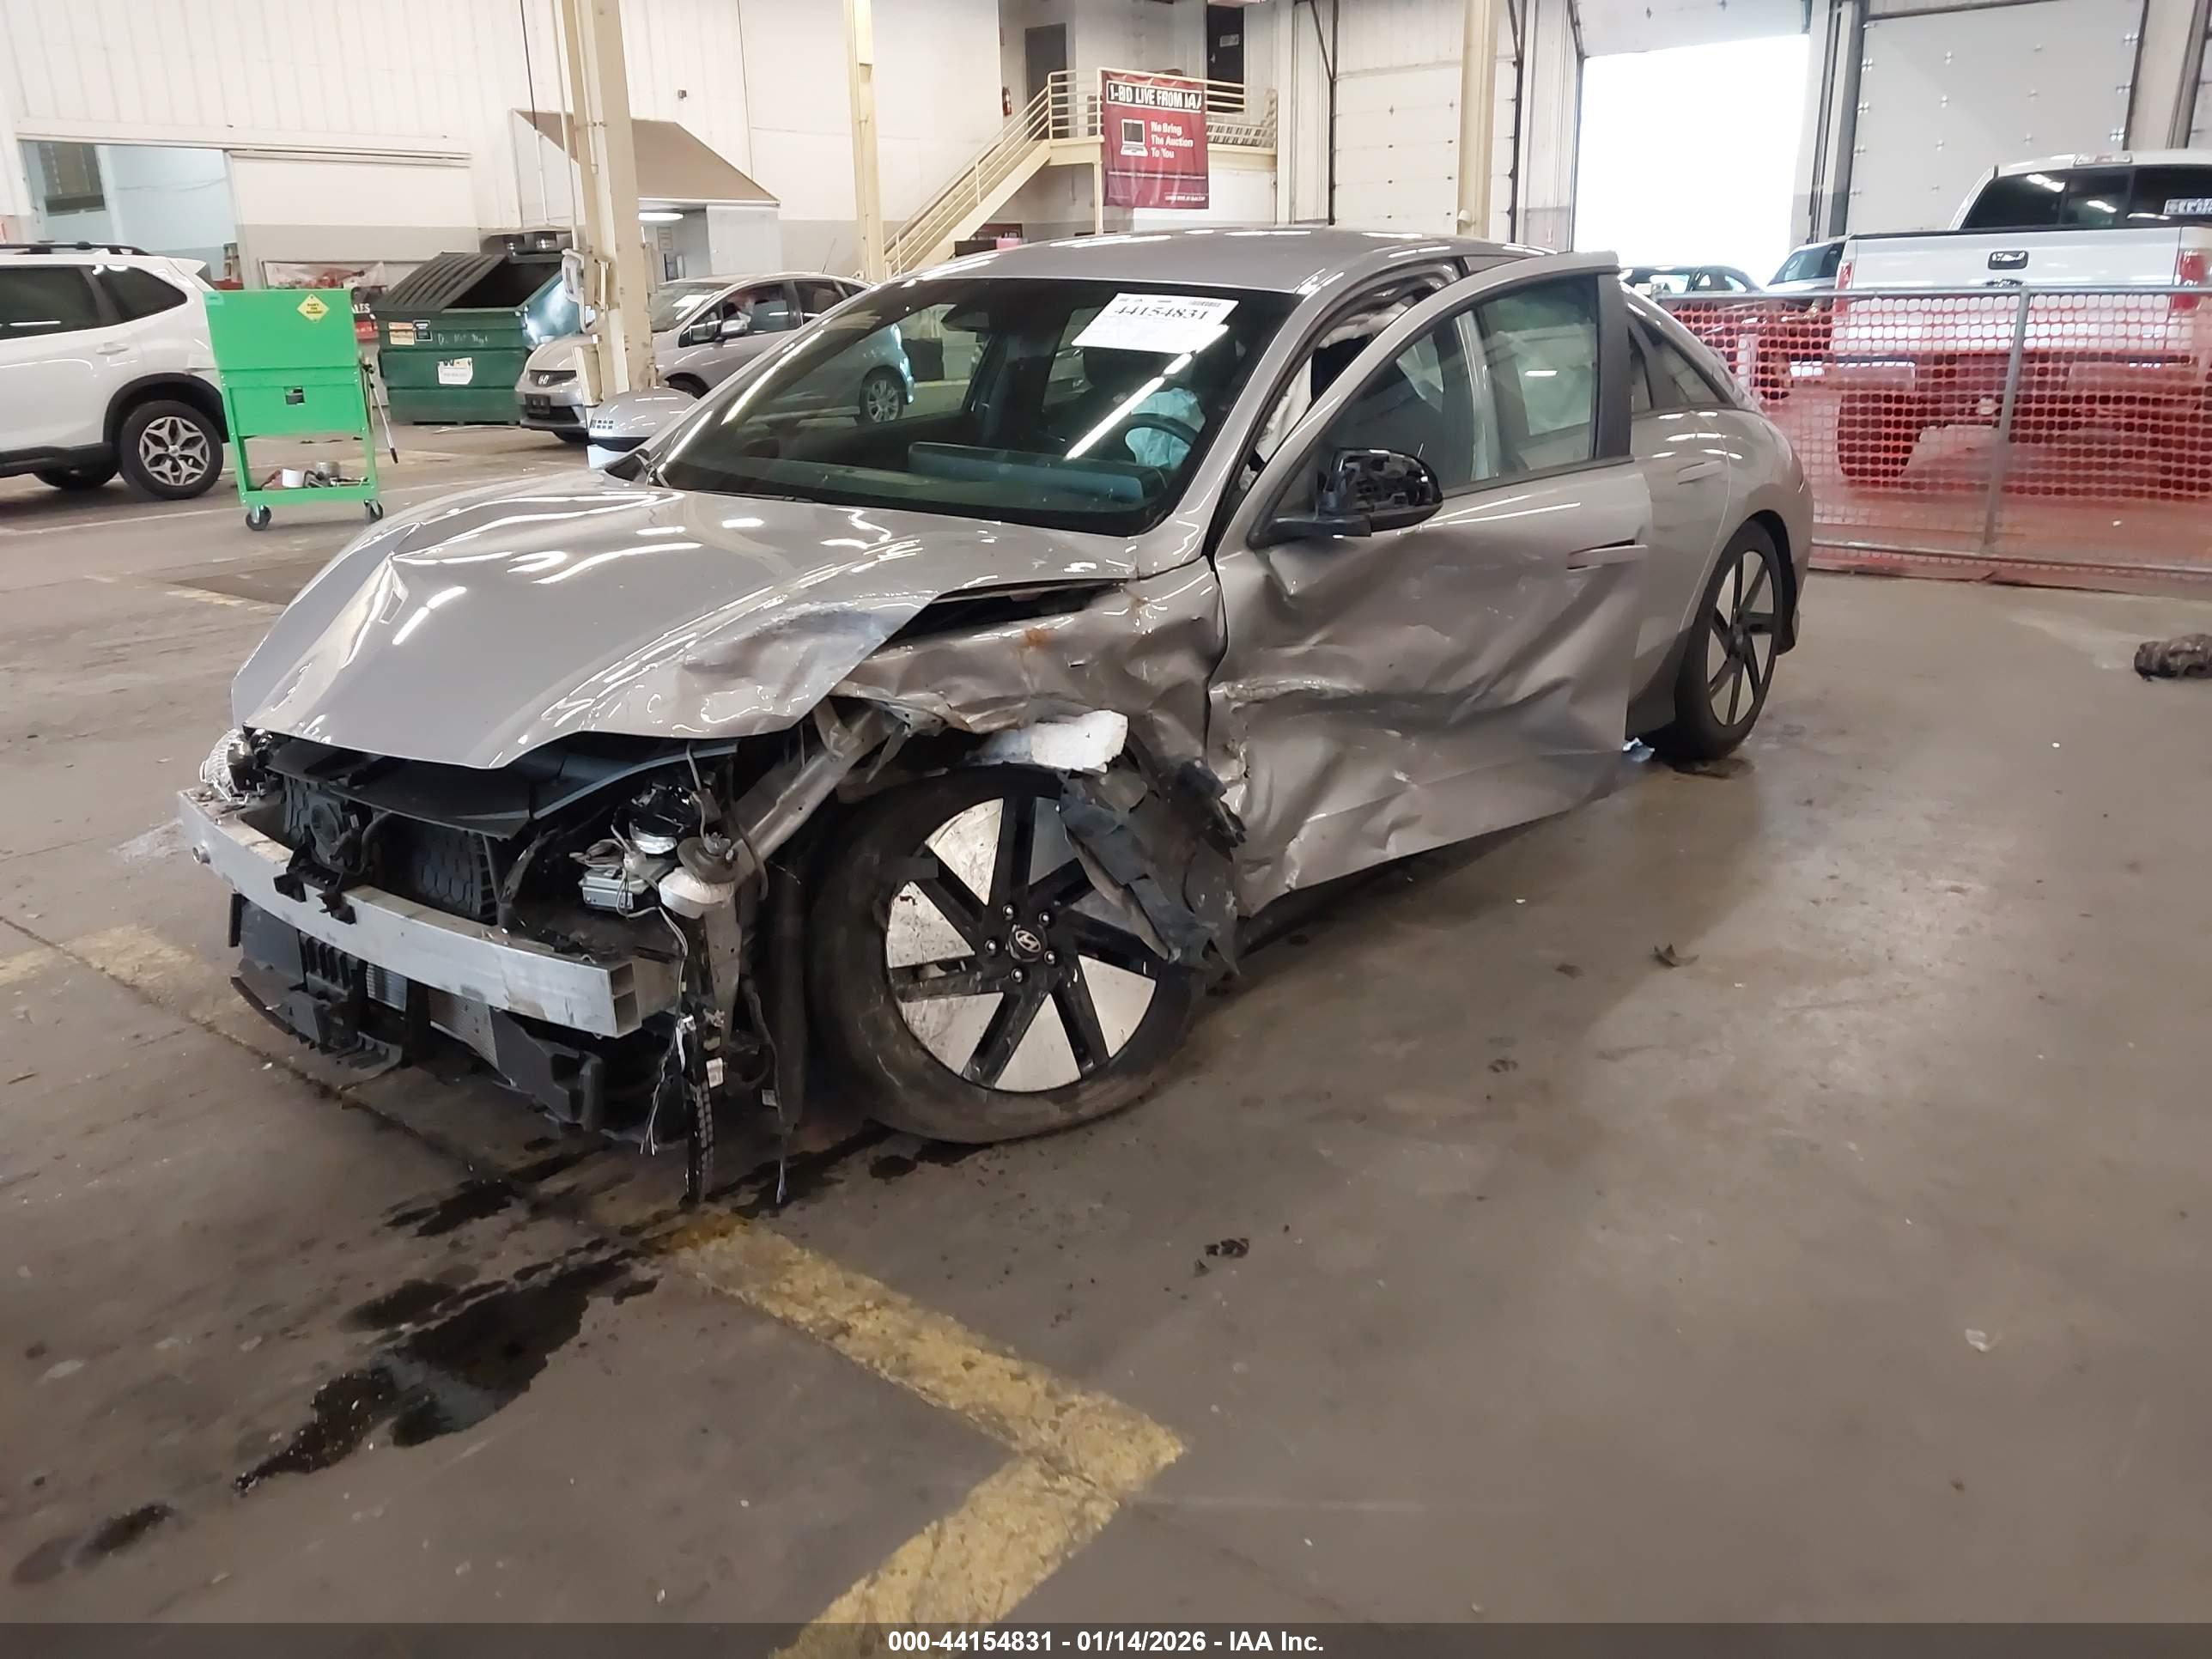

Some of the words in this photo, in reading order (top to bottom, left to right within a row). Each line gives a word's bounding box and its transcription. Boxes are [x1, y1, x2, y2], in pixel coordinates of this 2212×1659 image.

[1135, 87, 1155, 105] LIVE
[1156, 90, 1182, 108] FROM
[1151, 121, 1162, 132] We
[1163, 123, 1182, 136] Bring
[1151, 135, 1164, 145] The
[1165, 136, 1194, 148] Auction
[1151, 148, 1160, 157] To
[1161, 148, 1175, 159] You
[1115, 305, 1209, 319] 44154831
